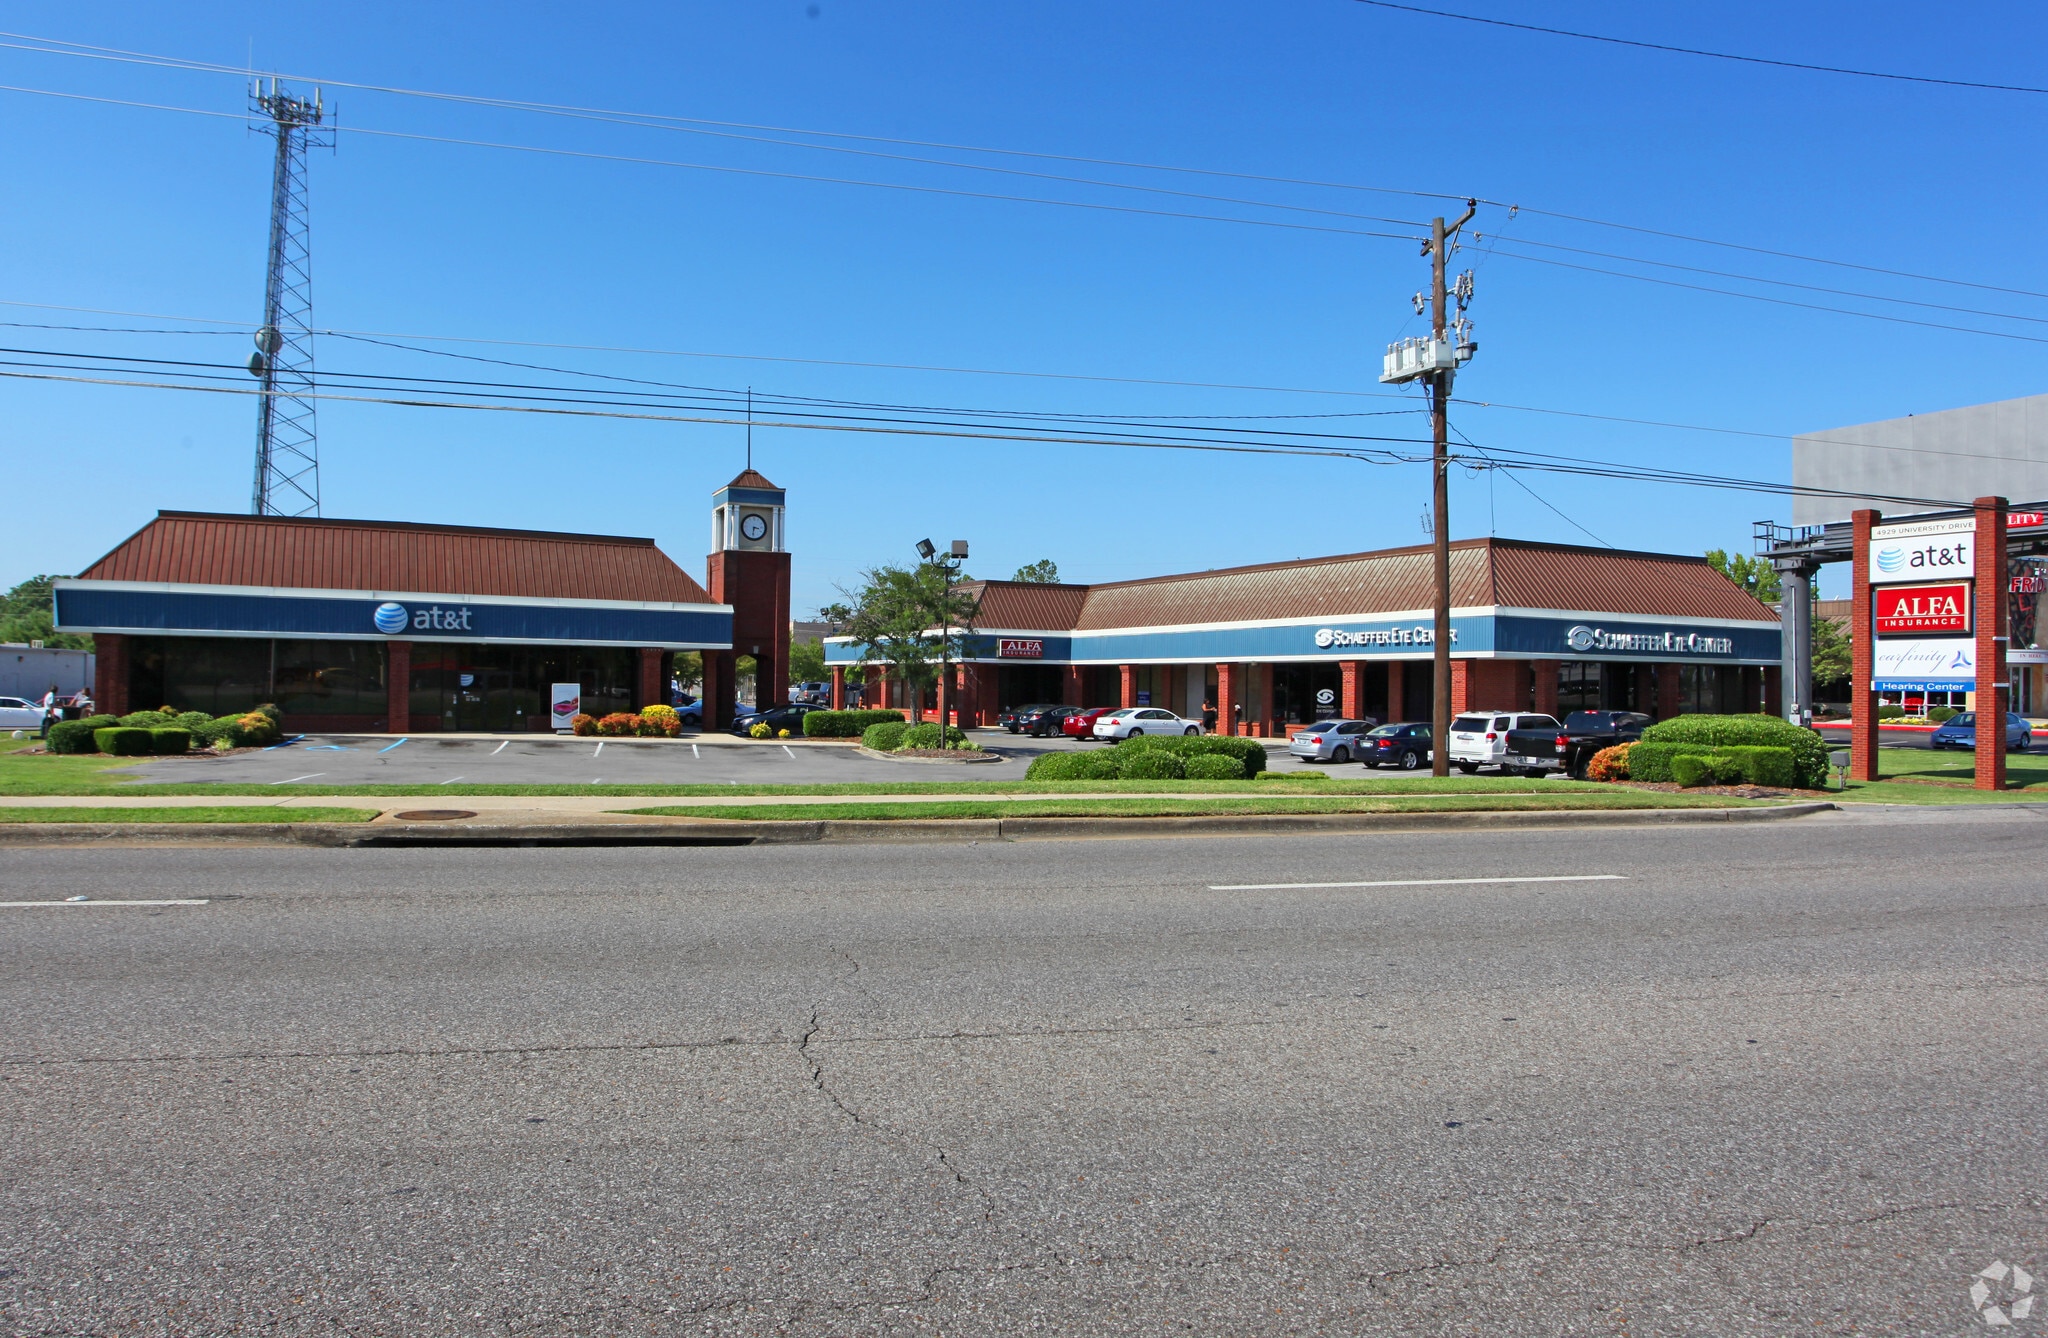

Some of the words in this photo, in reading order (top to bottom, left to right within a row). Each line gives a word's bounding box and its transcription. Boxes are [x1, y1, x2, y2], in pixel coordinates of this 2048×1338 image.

[1899, 525, 1945, 533] UNIVERSITY
[1910, 544, 1966, 567] at&t
[1893, 596, 1959, 616] ALFA
[414, 606, 472, 630] at&t
[1885, 618, 1956, 626] INSURANCE
[1334, 630, 1391, 645] SCHAEFFER
[1392, 627, 1411, 643] EYE
[1413, 626, 1458, 643] CENR
[1595, 629, 1664, 651] SCHAEFFER
[1665, 632, 1688, 652] EYE
[1688, 633, 1732, 653] CENTER
[1008, 642, 1041, 651] ALFA
[1882, 683, 1924, 691] Hearing
[1926, 682, 1964, 690] Center
